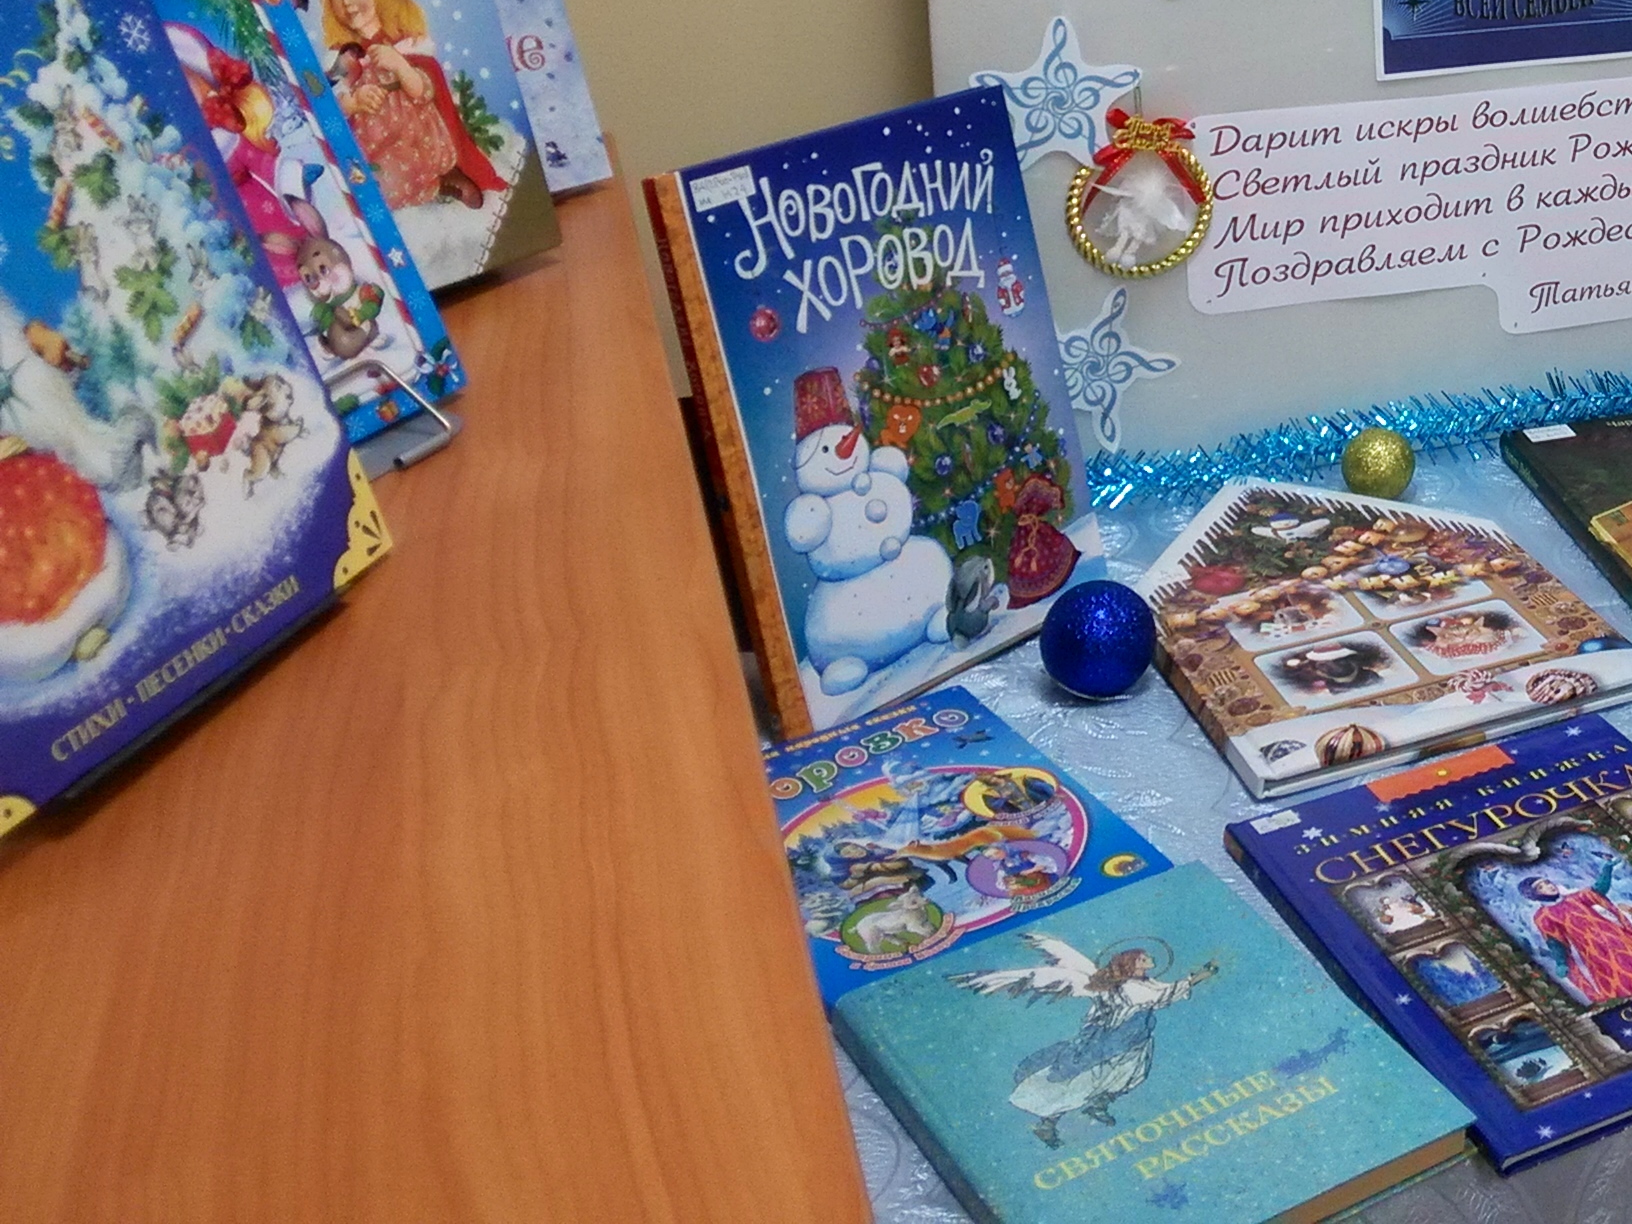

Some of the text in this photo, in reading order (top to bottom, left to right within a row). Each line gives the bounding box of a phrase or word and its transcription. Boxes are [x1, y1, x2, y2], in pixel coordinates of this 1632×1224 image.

[1209, 124, 1341, 160] Дарит
[1355, 112, 1458, 155] искры
[1211, 158, 1383, 203] Светлый
[1399, 141, 1557, 188] праздник
[1213, 212, 1305, 249] Мир
[1318, 194, 1494, 242] приходит
[1505, 183, 1524, 212] в
[782, 217, 986, 334] ХОРОВОД
[1213, 241, 1469, 299] Поздравляем
[1481, 236, 1500, 258] с
[50, 574, 300, 762] СТИХИ ПЕСЕНКИ СКАЗКИ
[1033, 1067, 1280, 1192] СВЯТОЧНЫЕ
[1132, 1074, 1340, 1181] РАССКАЗЫ
